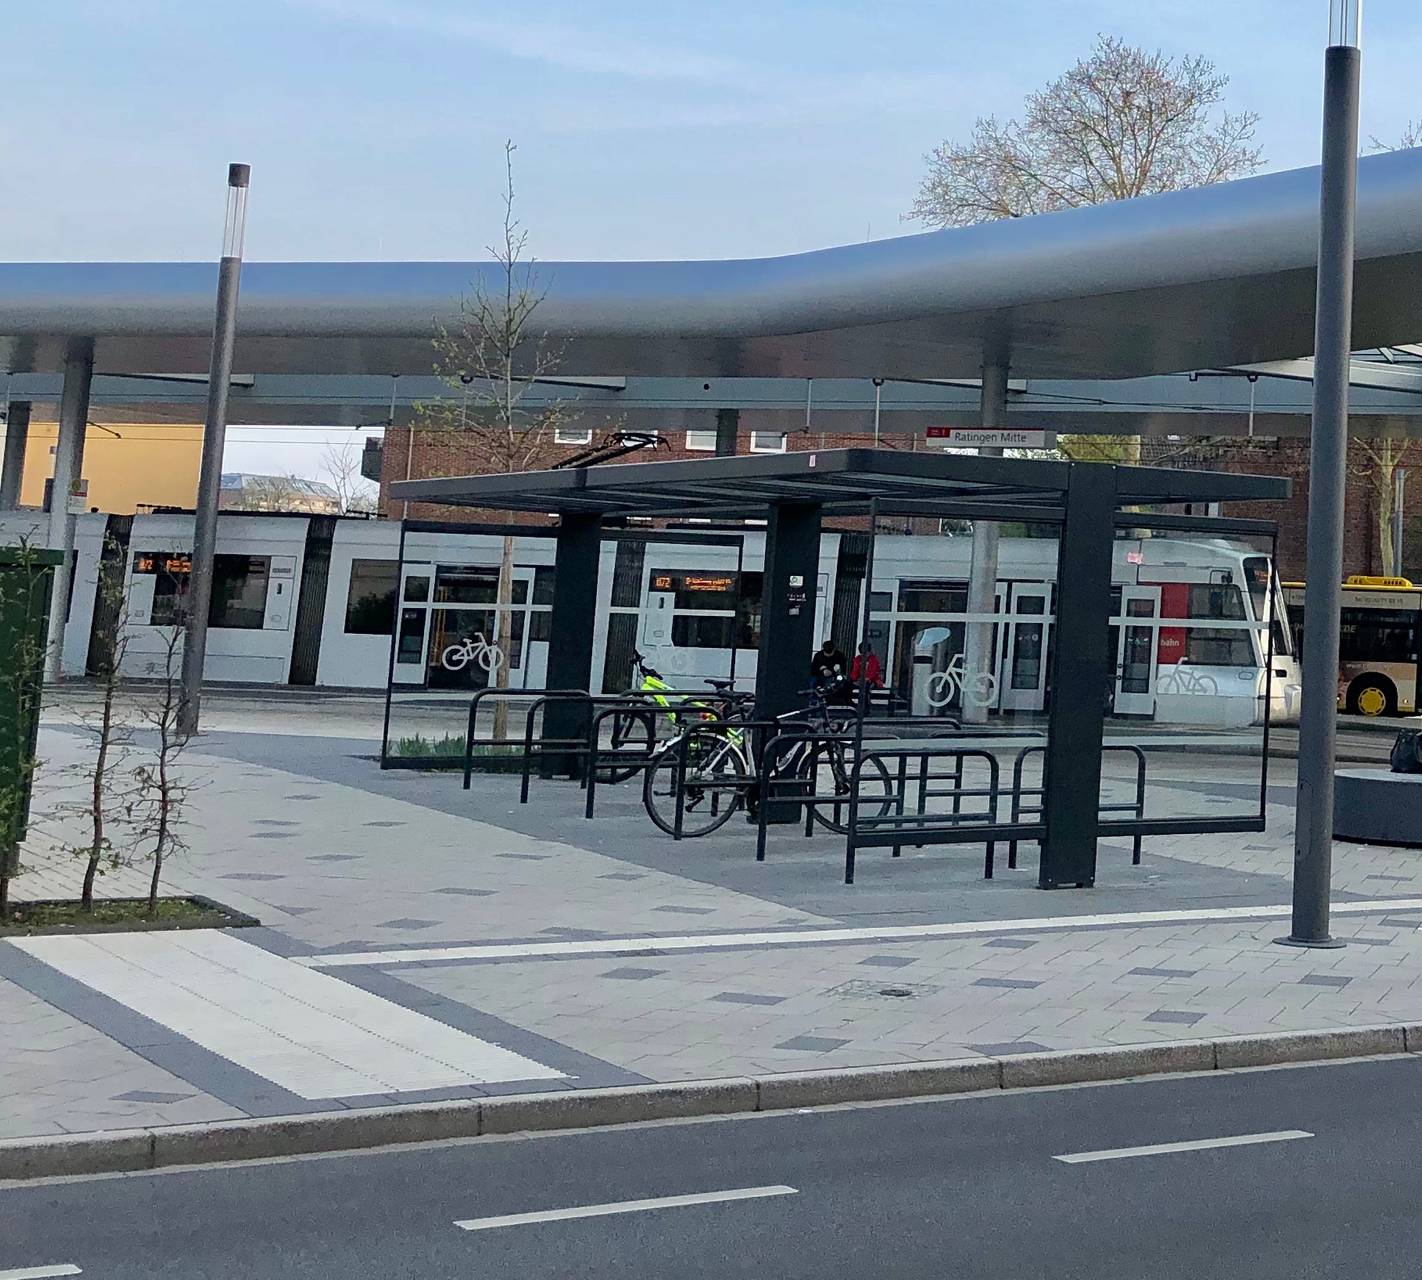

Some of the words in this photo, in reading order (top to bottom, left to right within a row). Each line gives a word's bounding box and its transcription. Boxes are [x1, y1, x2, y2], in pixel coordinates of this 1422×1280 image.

[954, 432, 997, 445] Ratingen
[1000, 433, 1027, 443] Mitte
[1160, 638, 1180, 647] bahn
